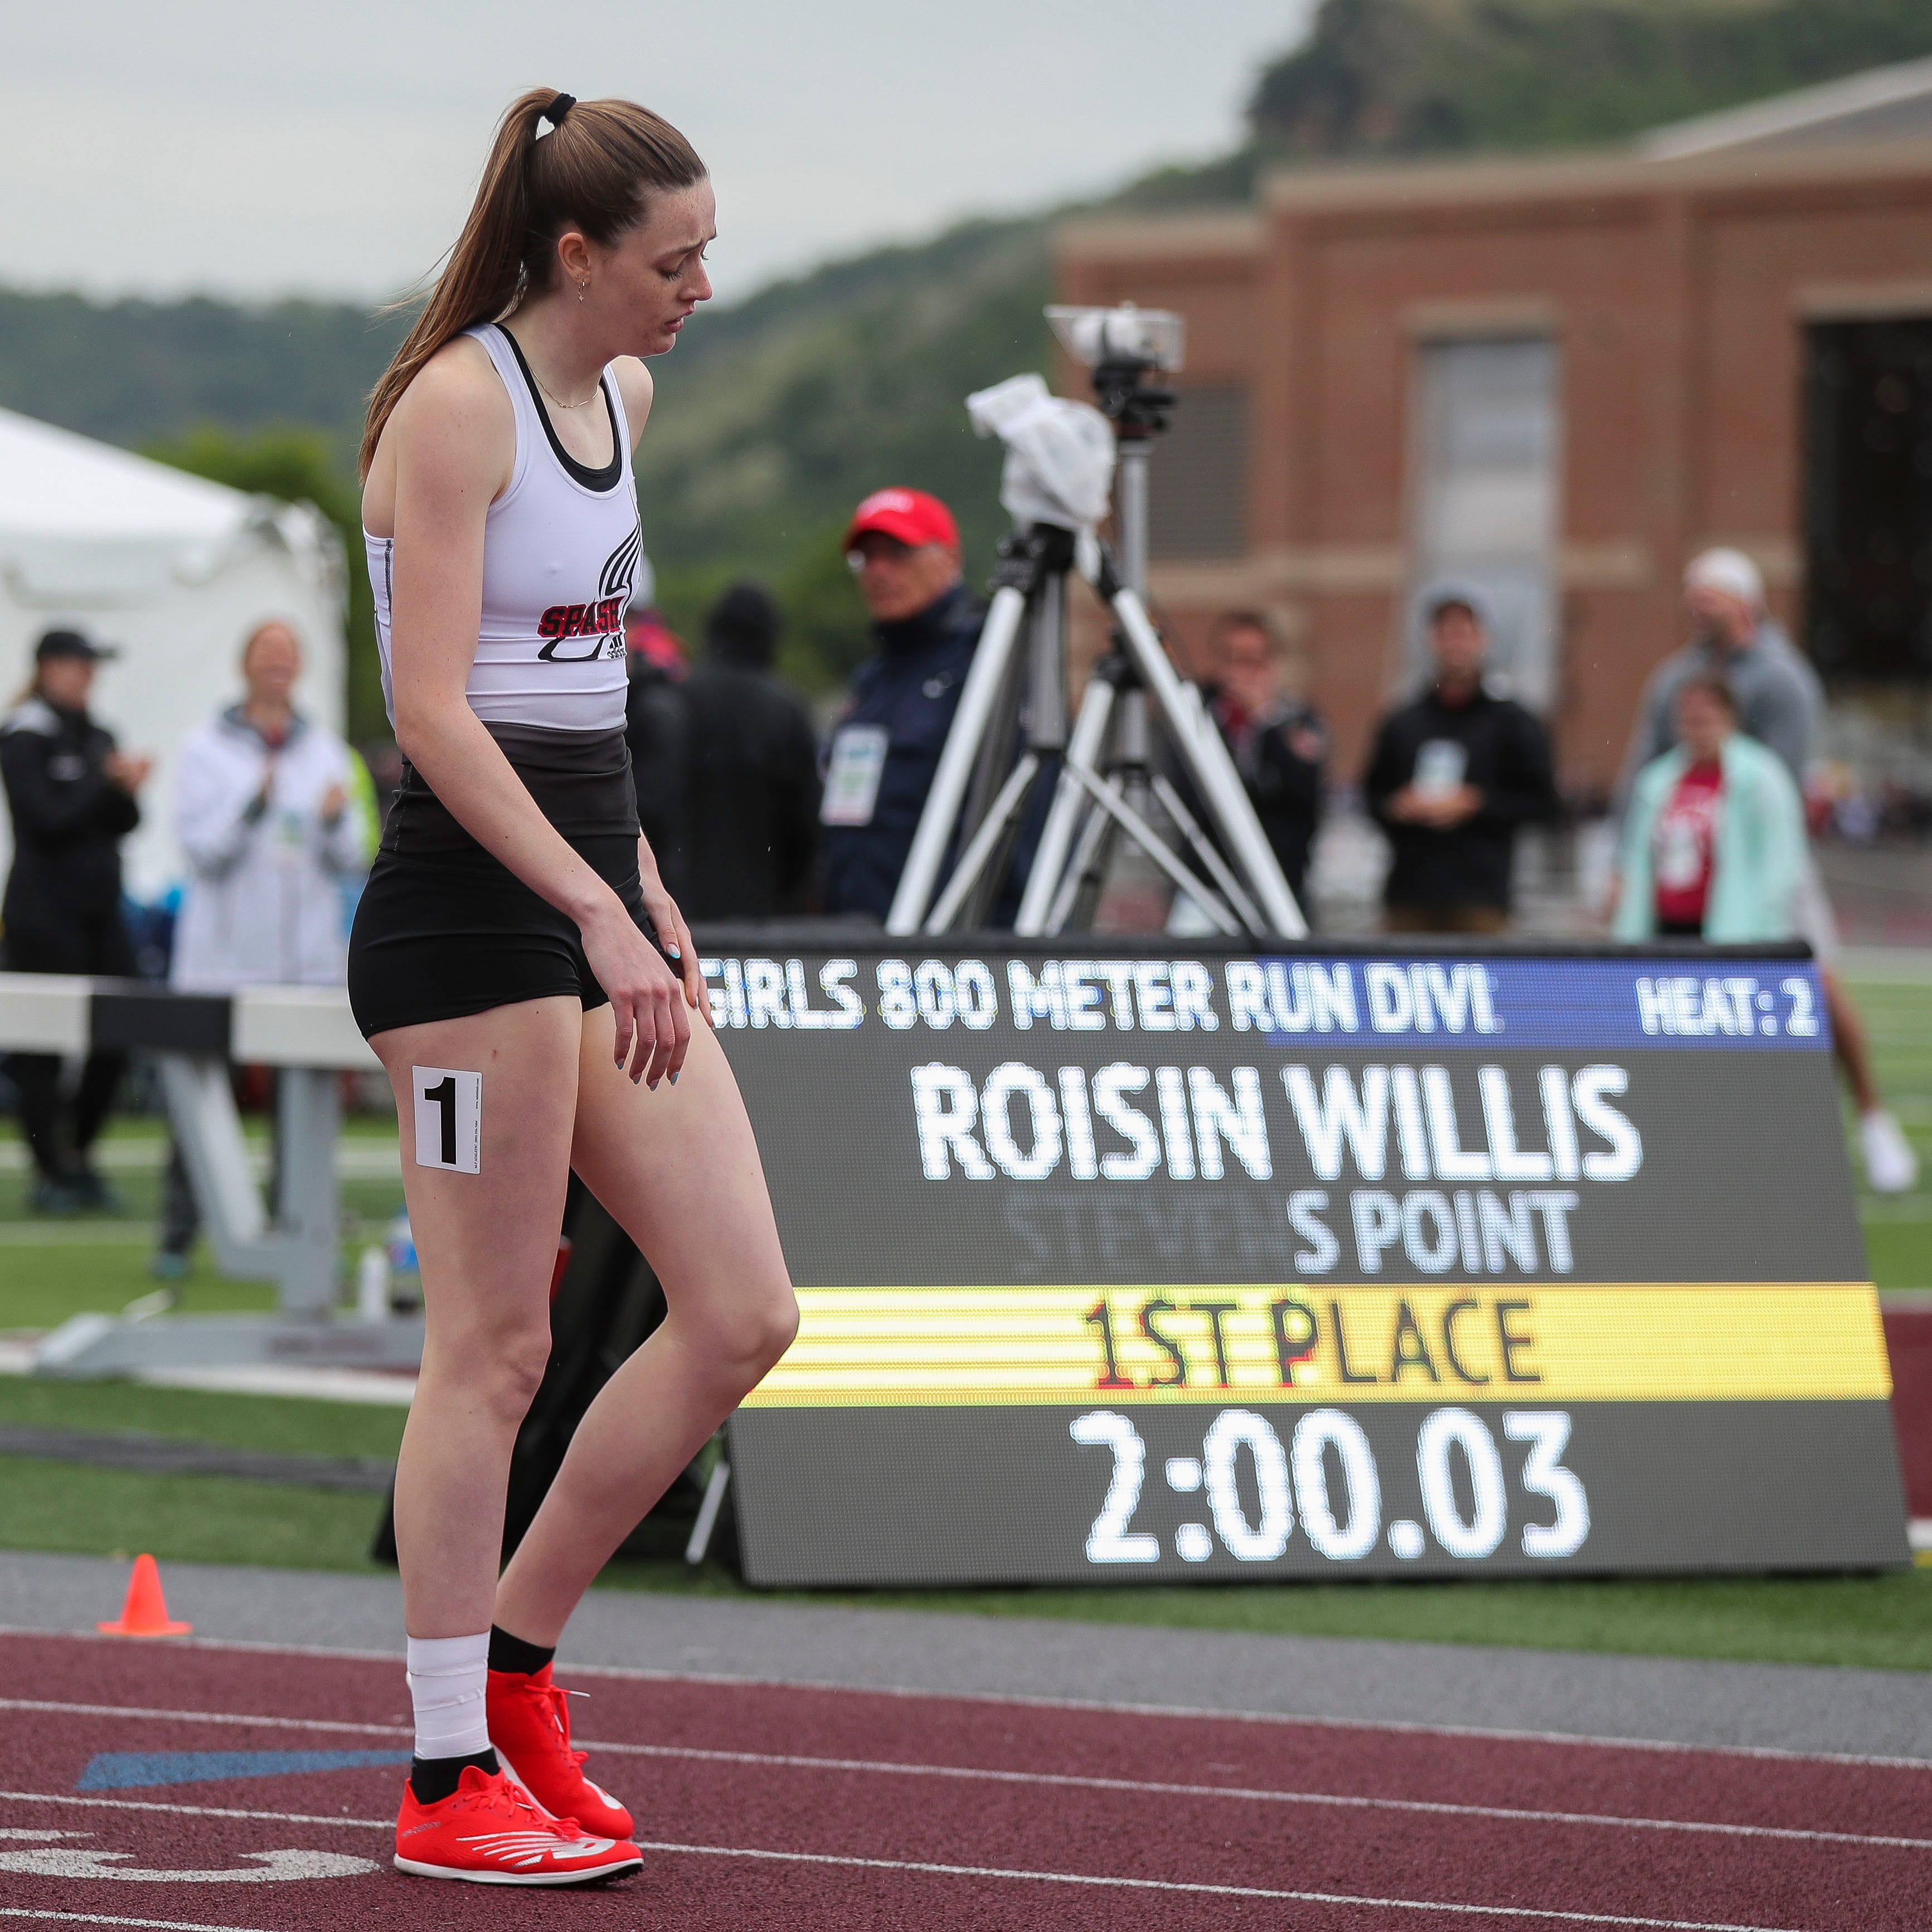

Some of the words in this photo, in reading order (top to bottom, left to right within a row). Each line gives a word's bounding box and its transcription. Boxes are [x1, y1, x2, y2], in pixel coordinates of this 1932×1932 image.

[537, 595, 625, 637] SPASH
[876, 959, 998, 1030] 800
[1007, 959, 1219, 1031] METER
[1224, 960, 1360, 1033] RUN
[1635, 977, 1778, 1036] HEAT:
[1780, 977, 1819, 1036] 2
[424, 1076, 457, 1165] 1
[910, 1062, 1273, 1180] ROISIN
[1280, 1063, 1643, 1181] WILLIS
[1349, 1190, 1580, 1274] POINT
[1085, 1299, 1237, 1389] 1ST
[1272, 1299, 1542, 1387] PLACE
[1069, 1408, 1589, 1562] 2:00.03
